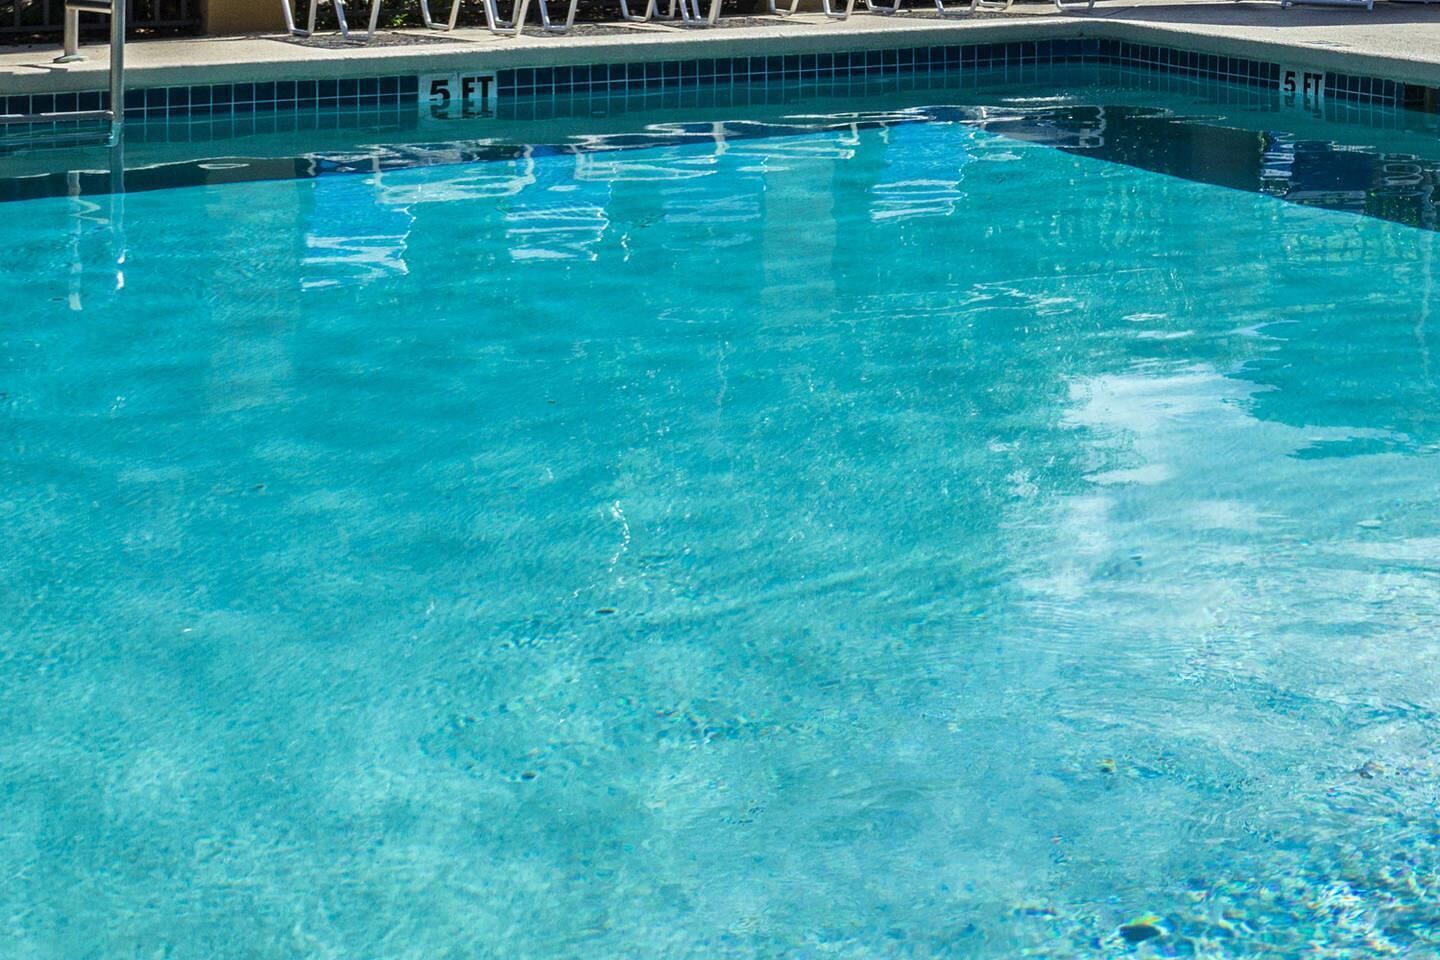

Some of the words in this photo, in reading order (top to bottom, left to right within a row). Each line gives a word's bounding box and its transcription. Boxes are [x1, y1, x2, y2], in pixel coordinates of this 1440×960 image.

[428, 79, 451, 101] 5
[462, 76, 494, 100] FT
[1283, 71, 1297, 92] 5
[1303, 72, 1323, 95] FT
